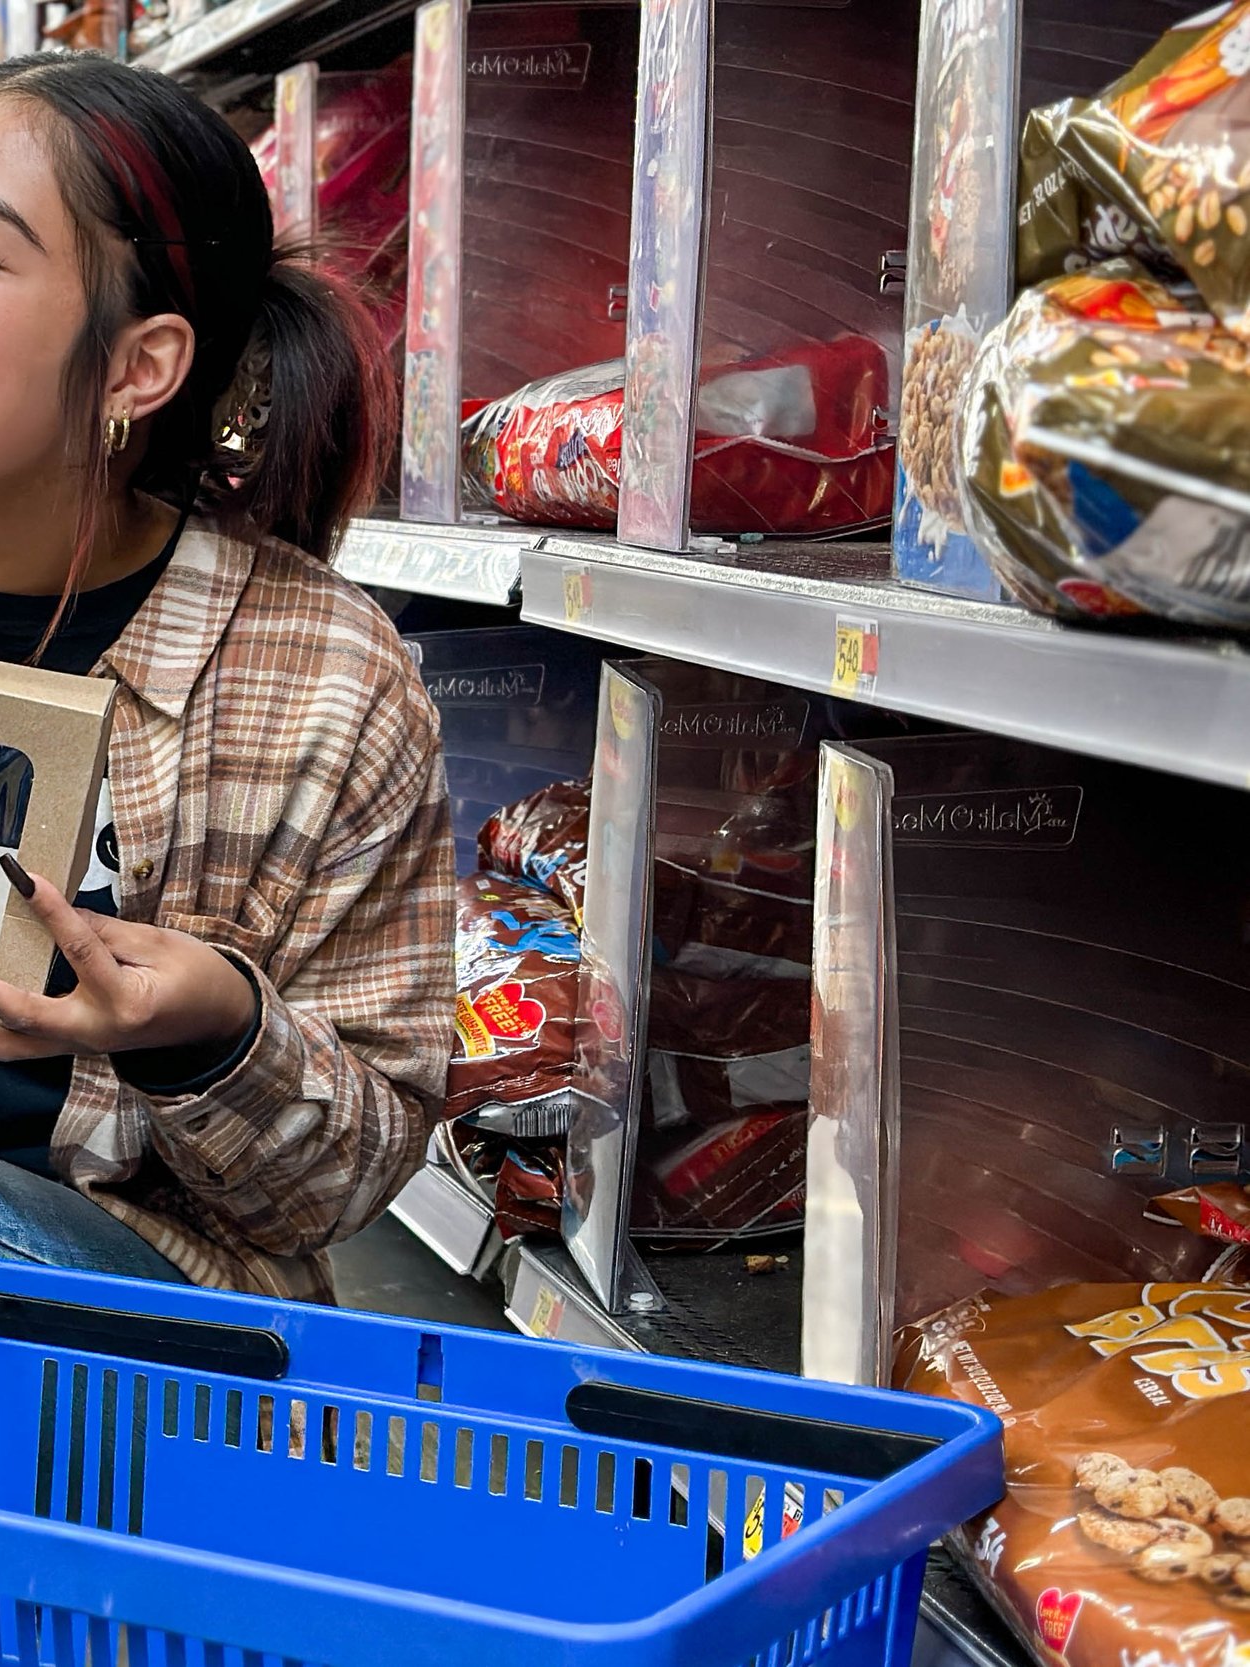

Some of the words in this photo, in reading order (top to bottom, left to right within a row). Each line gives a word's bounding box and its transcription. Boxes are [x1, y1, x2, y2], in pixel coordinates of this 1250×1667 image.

[480, 996, 519, 1034] FREE!
[1133, 1377, 1172, 1407] CEREAL
[1043, 1620, 1066, 1640] FREE!
